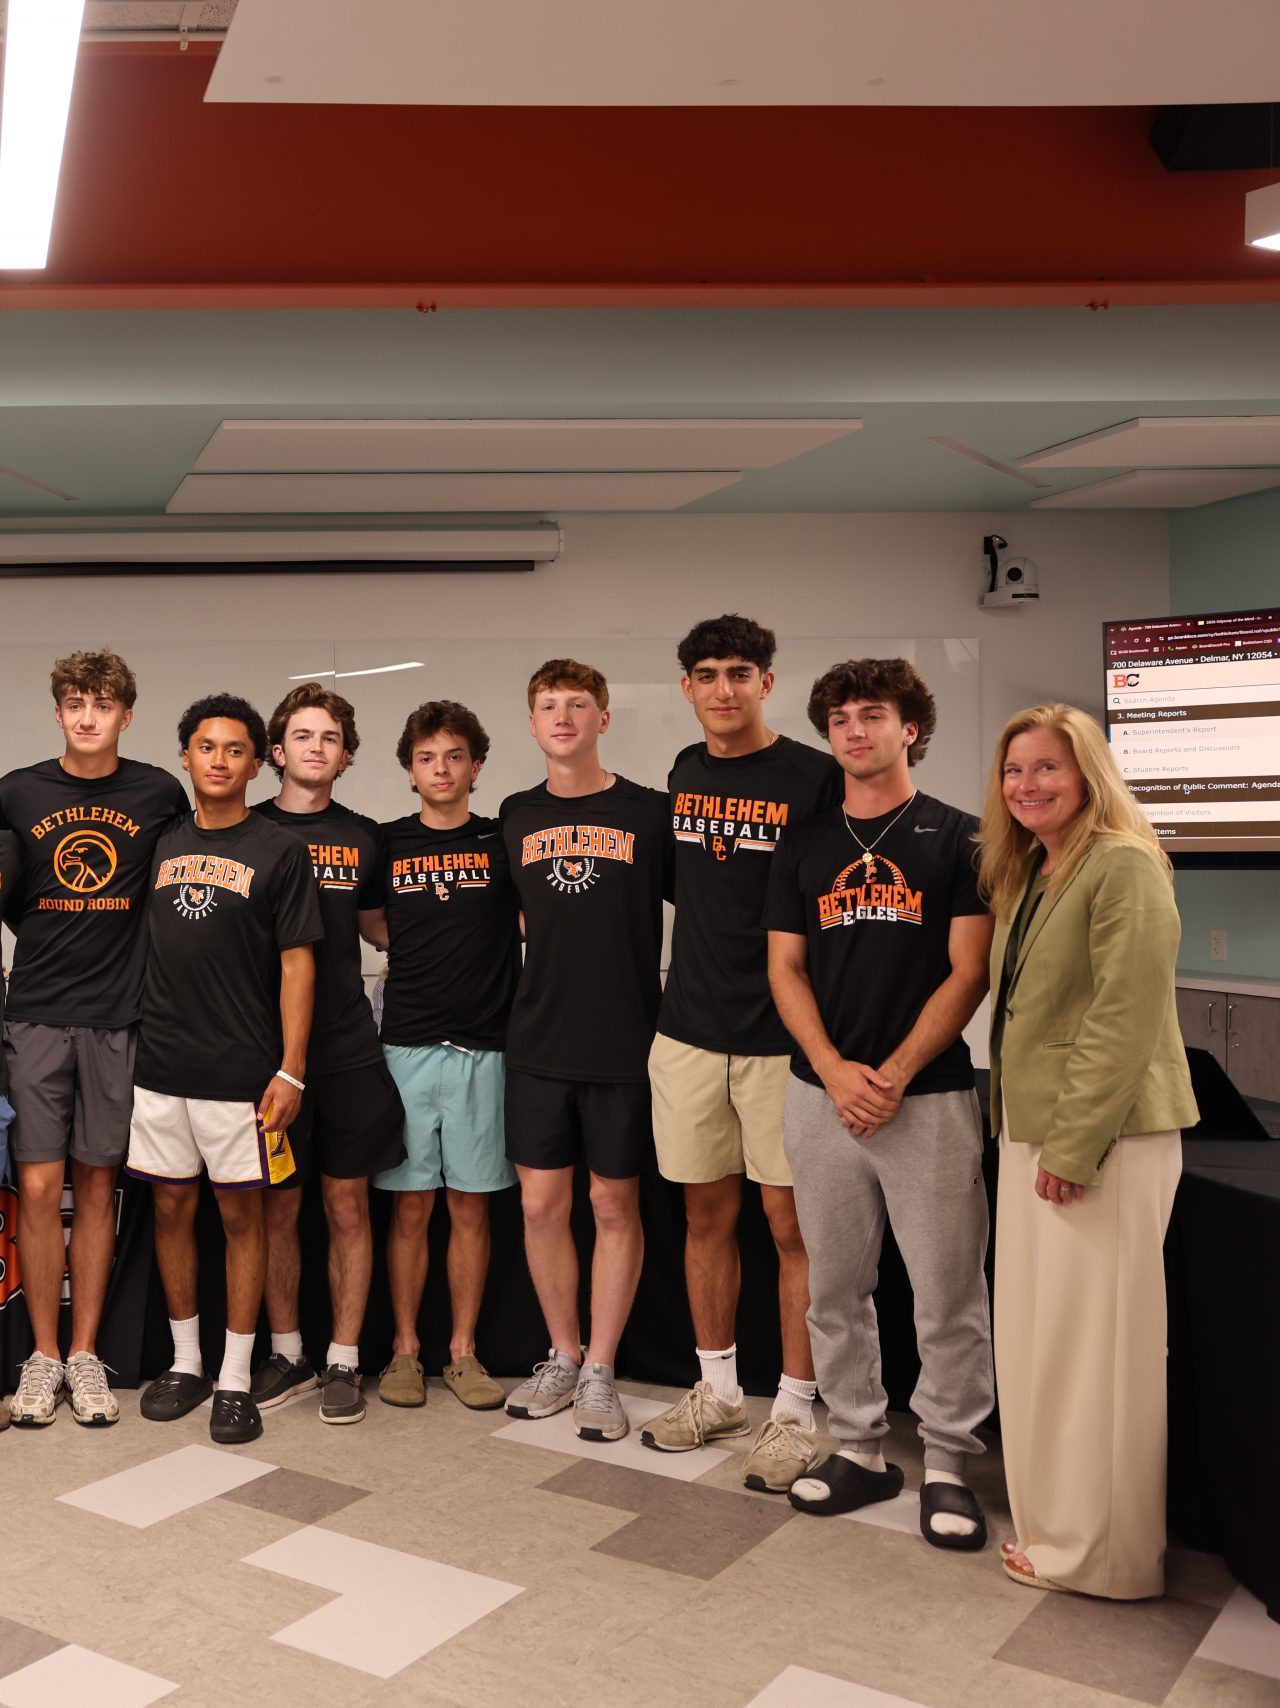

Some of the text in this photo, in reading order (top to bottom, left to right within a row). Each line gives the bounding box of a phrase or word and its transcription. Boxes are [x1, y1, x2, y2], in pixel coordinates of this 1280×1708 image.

[1128, 660, 1163, 668] Delaware
[1246, 651, 1272, 659] 12054
[1113, 674, 1140, 688] BC
[1132, 728, 1190, 736] Superintendent's
[1193, 726, 1216, 734] Report
[1199, 744, 1240, 752] Discussions
[1128, 784, 1171, 792] Recognition
[674, 792, 788, 826] BETHLEHEM
[31, 806, 140, 839] BETHLEHEM
[522, 825, 635, 867] BETHLEHEM
[393, 853, 490, 876] BETHLEHEM
[154, 854, 255, 898] BETHLEHEM
[393, 869, 490, 887] BASEBALL
[546, 872, 600, 894] BASEBALL
[39, 898, 130, 912] ROUND ROBIN
[173, 898, 218, 920] BASEBALL
[843, 906, 898, 926] EGLES
